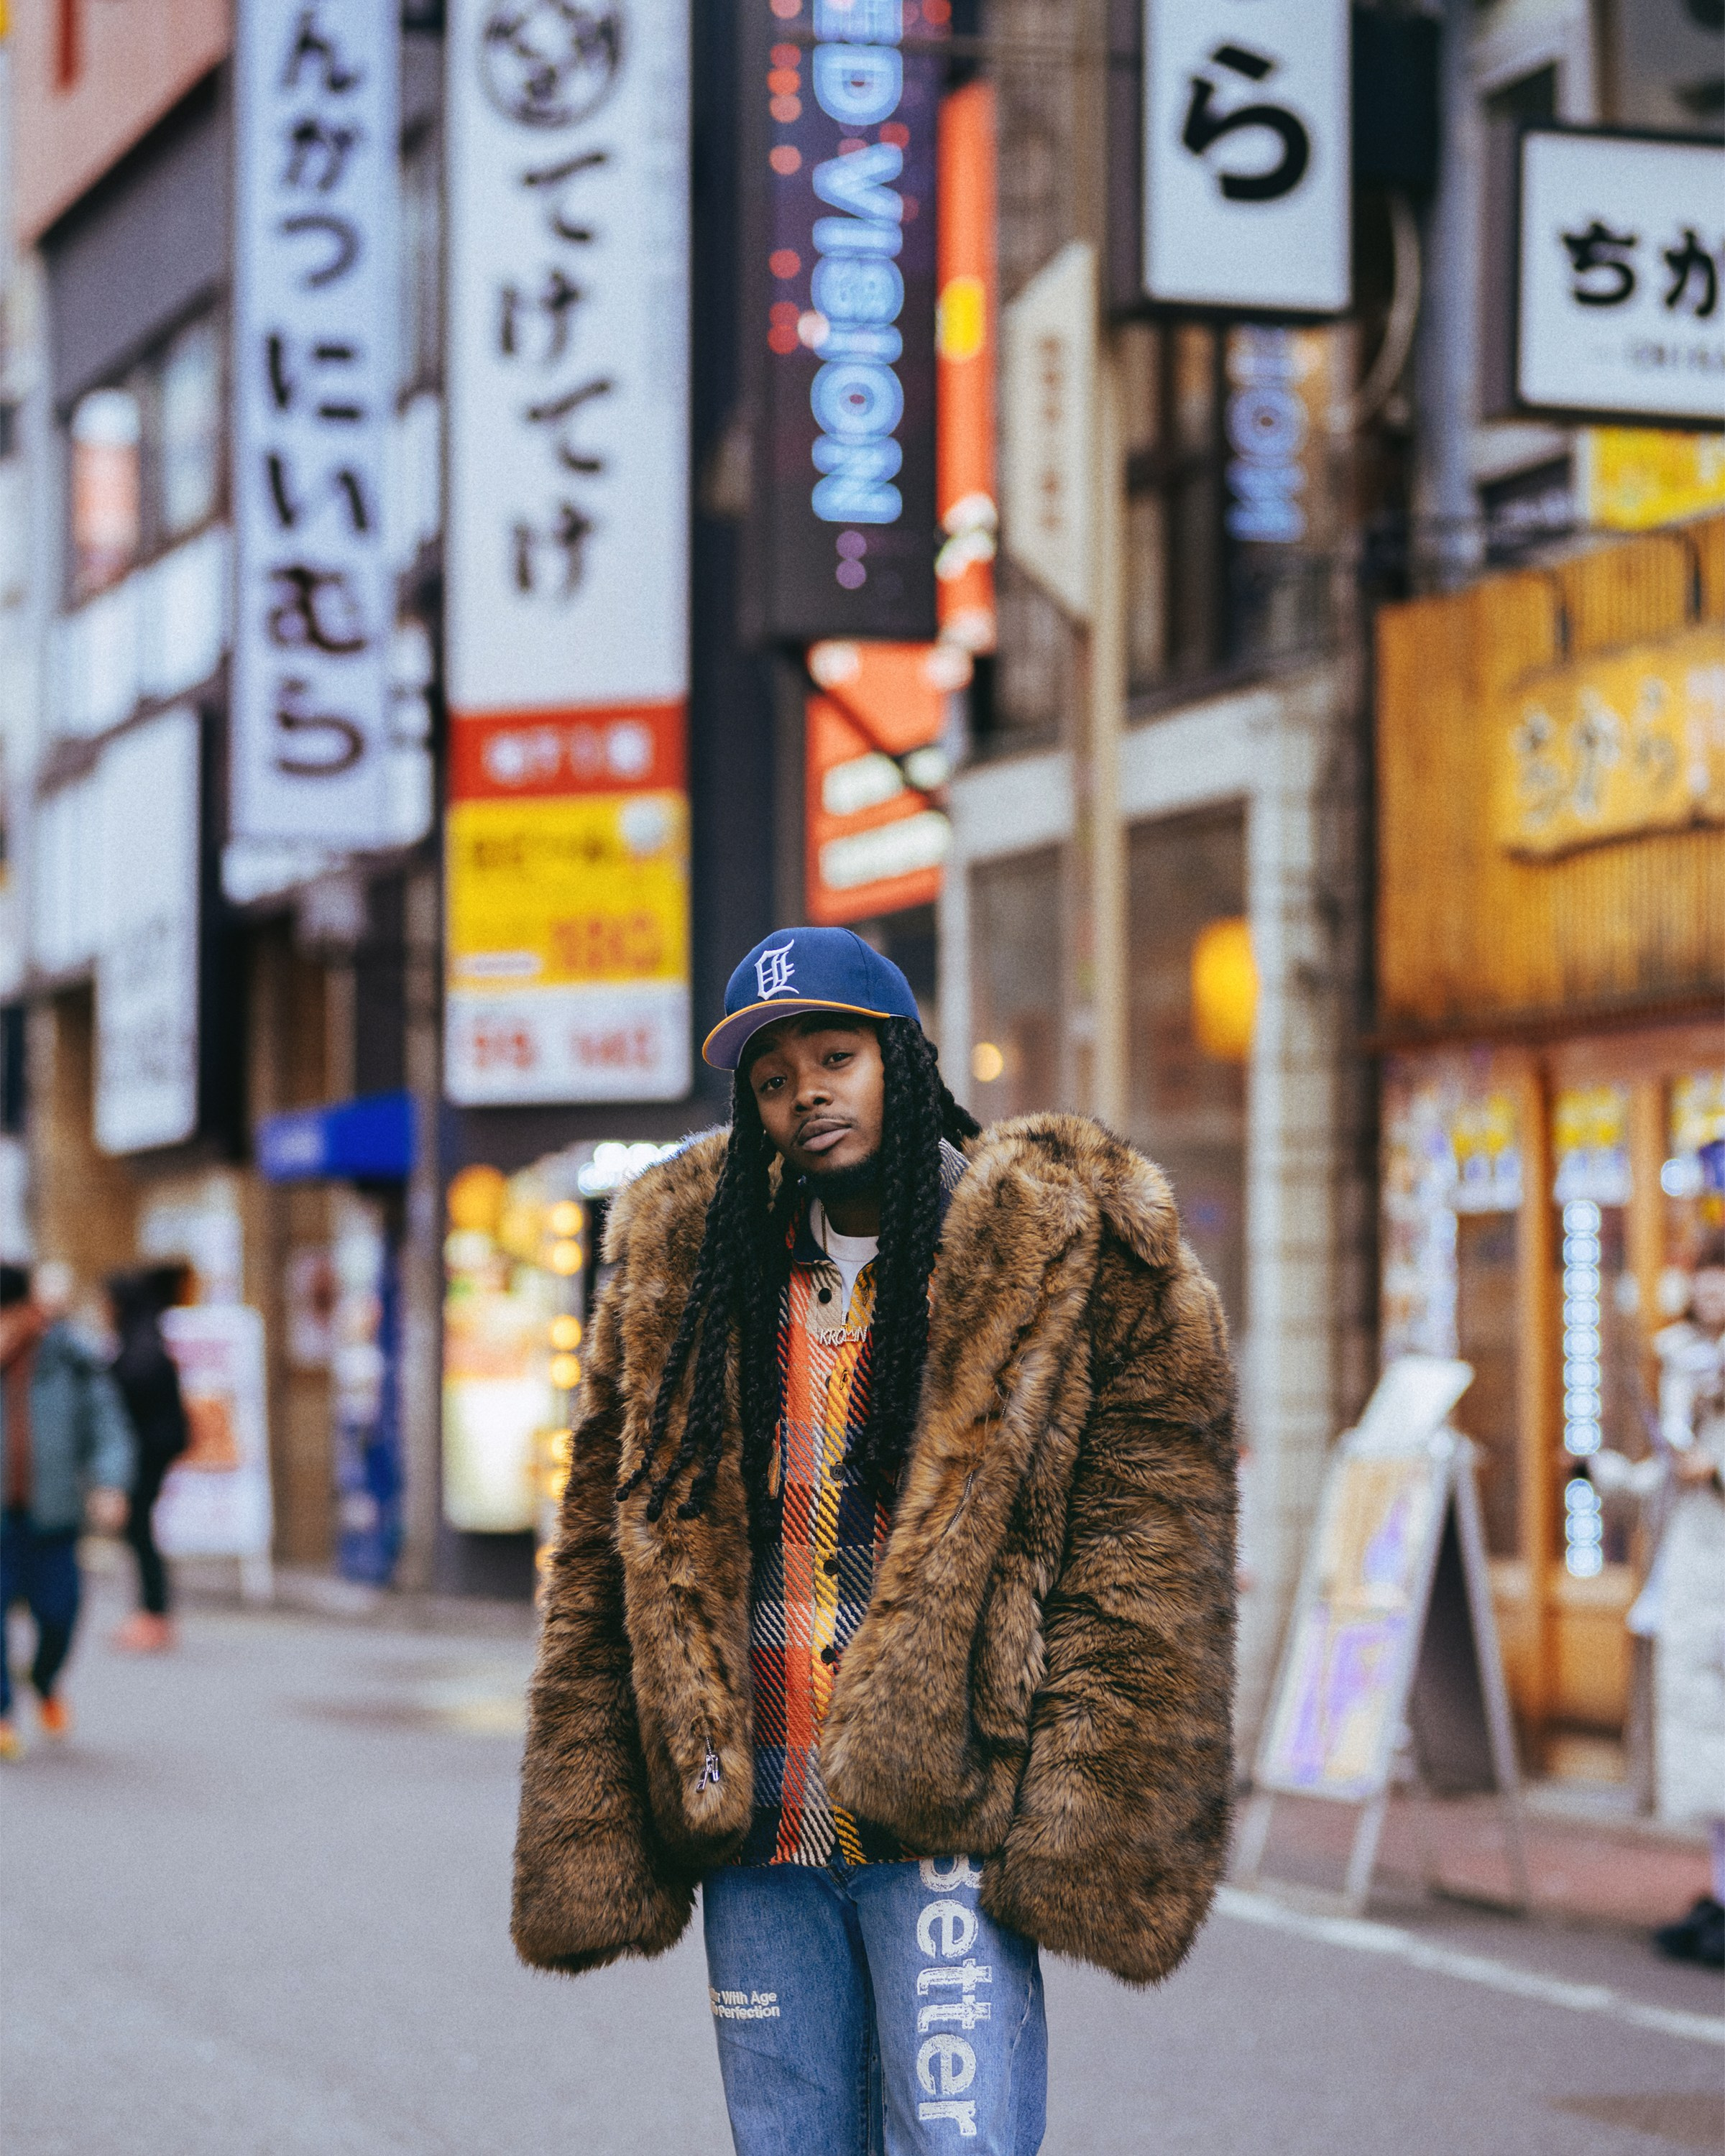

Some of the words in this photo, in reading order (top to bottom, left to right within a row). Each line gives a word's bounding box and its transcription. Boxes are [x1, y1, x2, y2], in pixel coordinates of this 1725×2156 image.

[1182, 44, 1310, 202] ら
[810, 142, 905, 524] VISION
[719, 2004, 781, 2020] Perfection
[721, 1991, 748, 2005] With
[750, 1991, 778, 2006] Age
